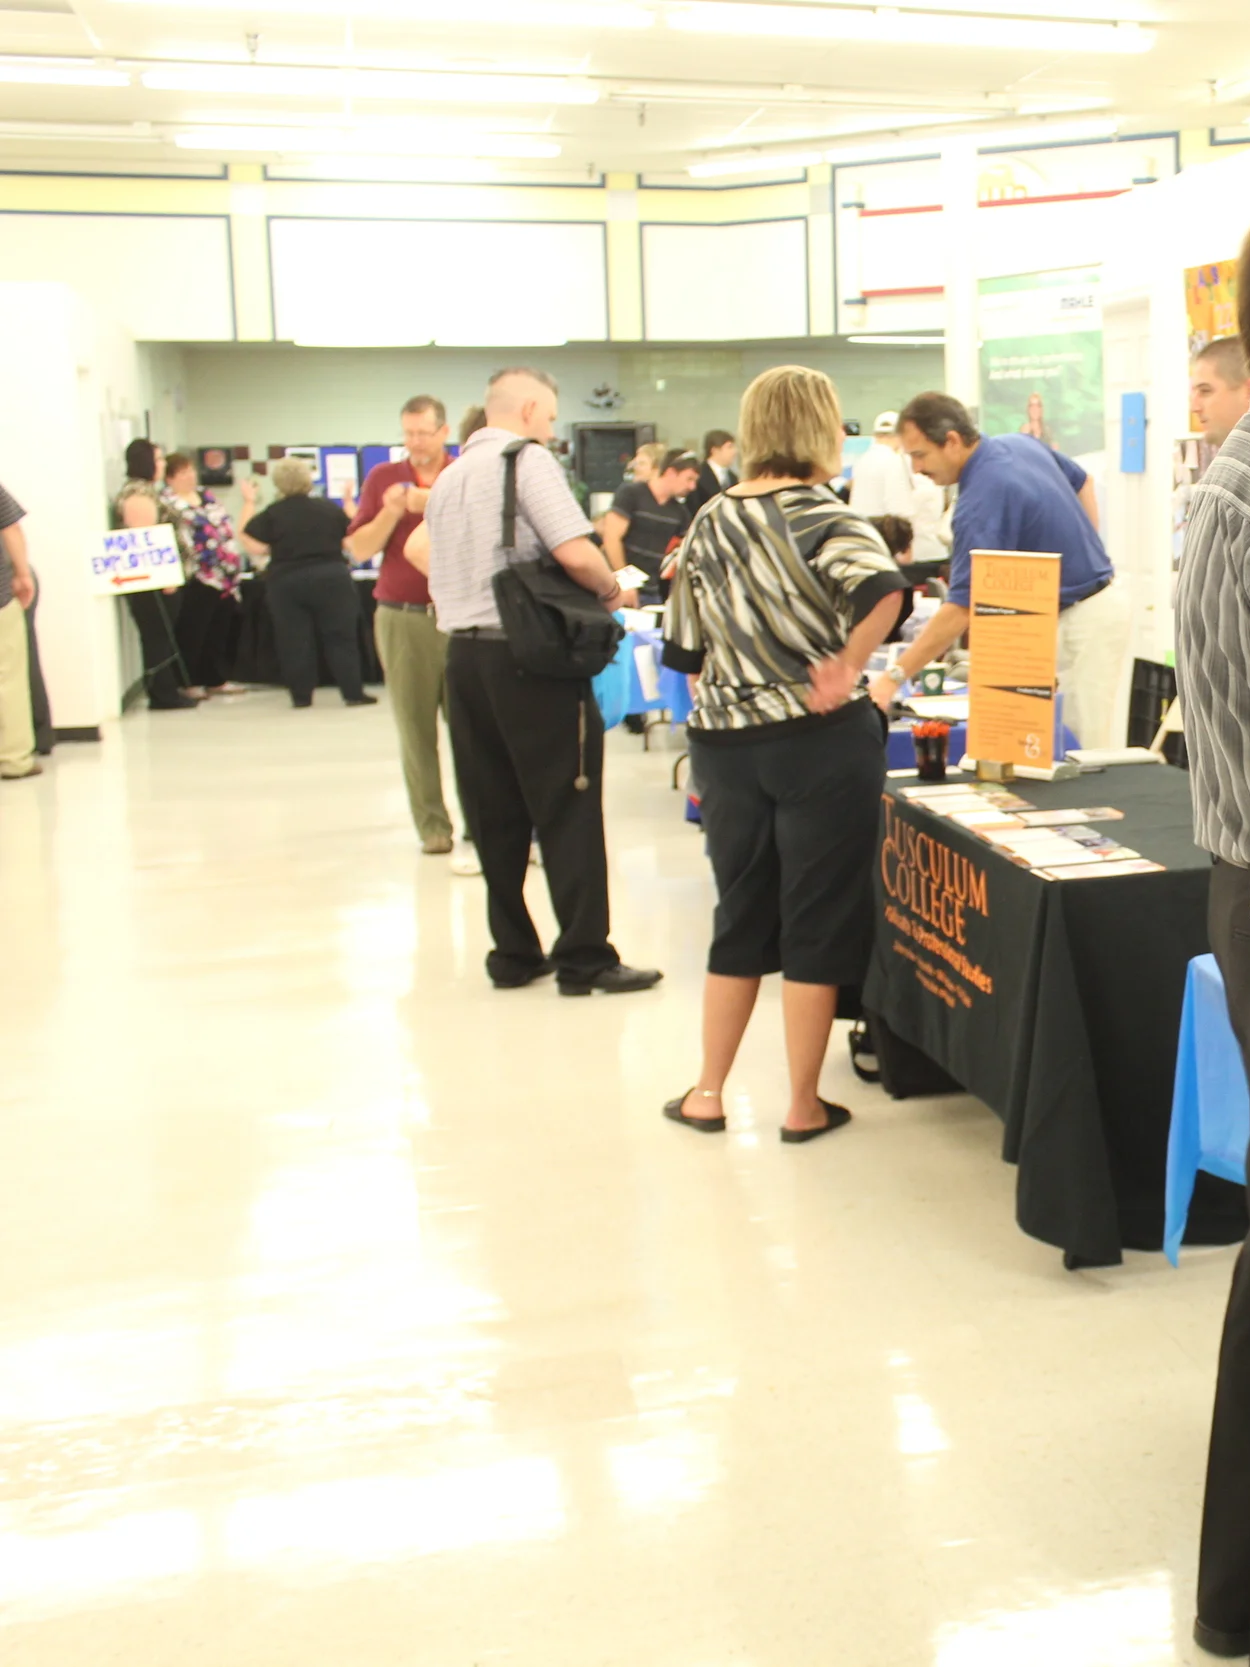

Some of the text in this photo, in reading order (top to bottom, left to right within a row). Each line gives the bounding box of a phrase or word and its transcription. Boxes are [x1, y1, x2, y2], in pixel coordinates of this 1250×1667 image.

[103, 531, 154, 552] MORE
[881, 793, 989, 917] TUSCULUM
[881, 837, 967, 946] COLLEGE
